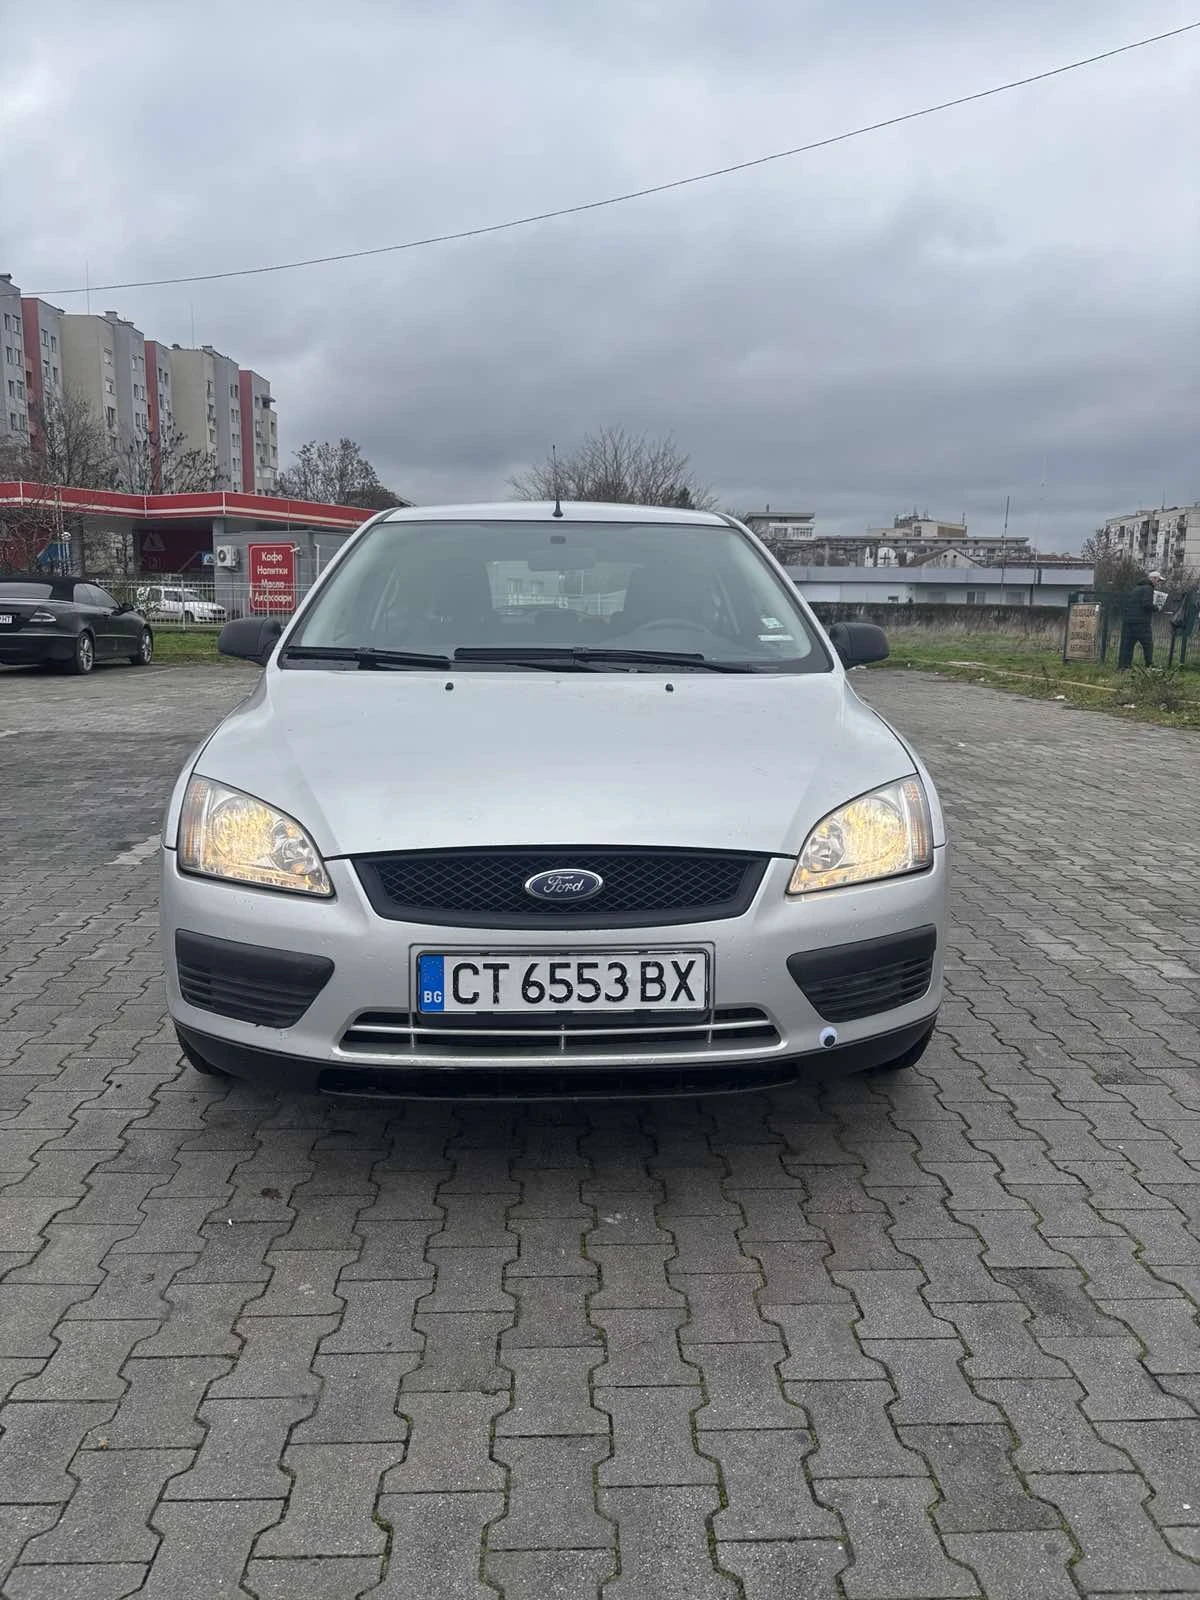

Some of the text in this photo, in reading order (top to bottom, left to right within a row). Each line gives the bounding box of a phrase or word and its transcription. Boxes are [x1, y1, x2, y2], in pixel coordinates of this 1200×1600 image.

[261, 551, 283, 564] Кафе
[256, 565, 288, 575] Напитки
[543, 876, 584, 892] Ford
[452, 960, 696, 1004] CT 6553 BX
[423, 990, 442, 1003] BG
